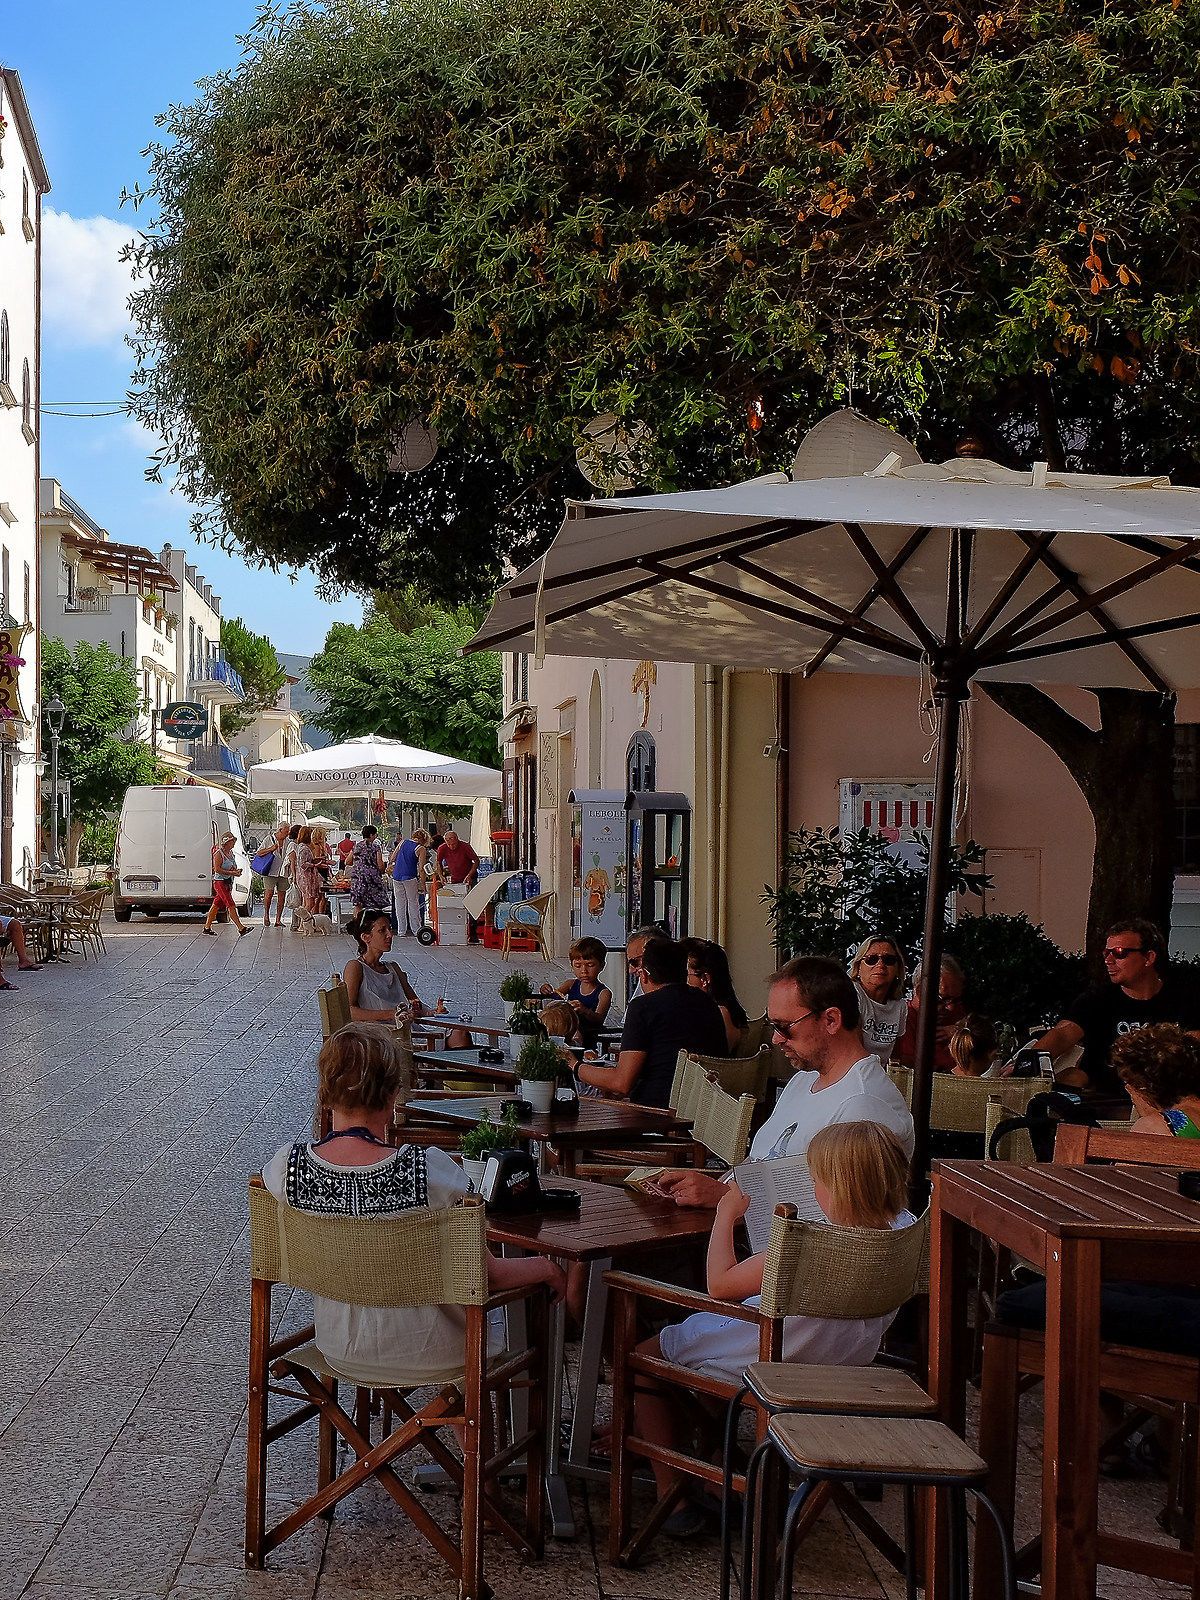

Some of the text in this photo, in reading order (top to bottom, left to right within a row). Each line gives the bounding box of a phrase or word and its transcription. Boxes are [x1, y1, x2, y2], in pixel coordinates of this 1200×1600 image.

[294, 770, 455, 784] L'ANGOLO DELLA FRUTTA
[364, 779, 402, 787] LEONINA
